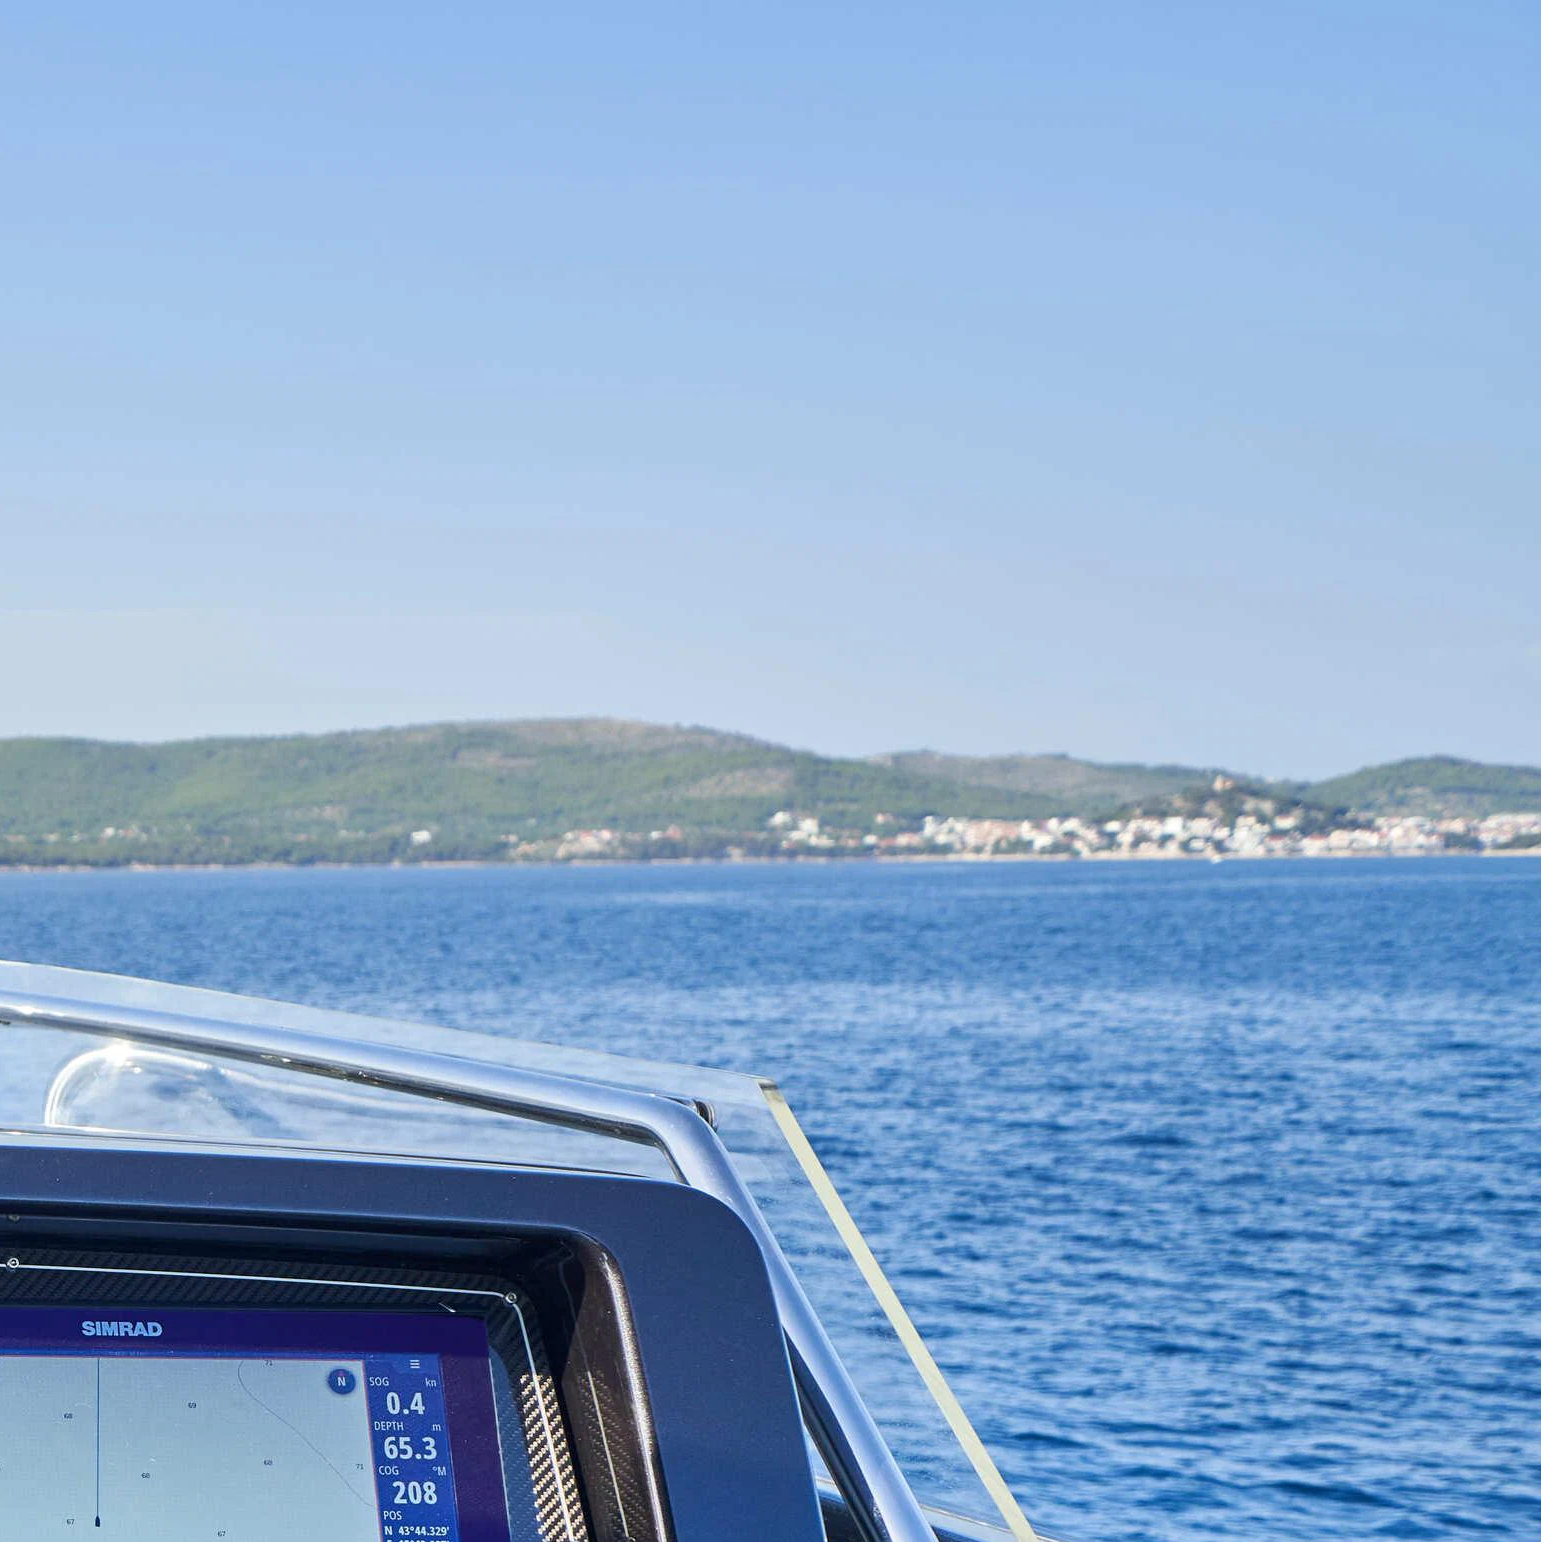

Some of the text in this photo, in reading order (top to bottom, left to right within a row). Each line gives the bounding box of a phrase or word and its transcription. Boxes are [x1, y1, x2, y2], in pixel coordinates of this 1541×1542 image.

[81, 1320, 163, 1337] SIMRAD
[337, 1376, 346, 1387] N
[369, 1376, 390, 1386] SOG
[425, 1377, 437, 1387] kn
[386, 1391, 425, 1415] 0.4
[374, 1421, 404, 1431] DEPTH
[432, 1423, 442, 1431] m
[384, 1436, 437, 1460] 65.3
[378, 1465, 399, 1475] COG
[392, 1480, 438, 1505] 208
[383, 1510, 402, 1520] POS
[66, 1518, 75, 1526] 67
[384, 1525, 393, 1536] N
